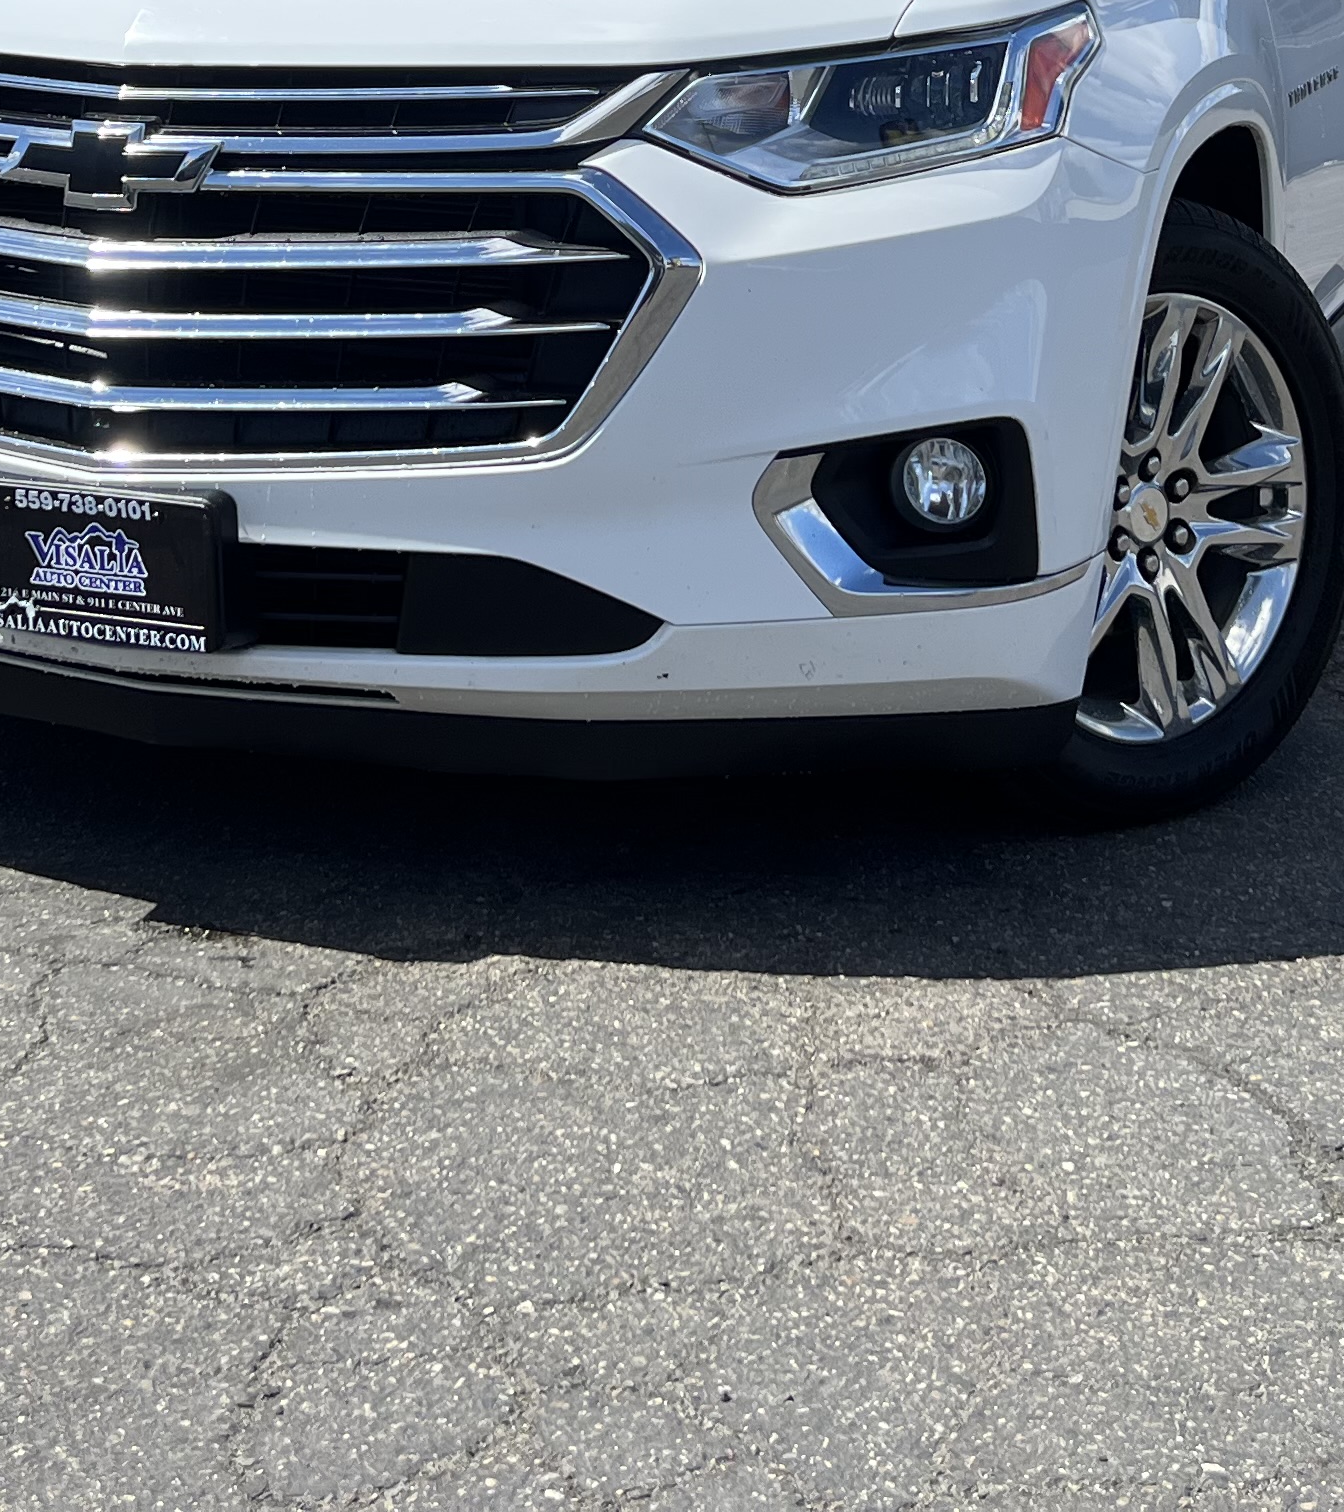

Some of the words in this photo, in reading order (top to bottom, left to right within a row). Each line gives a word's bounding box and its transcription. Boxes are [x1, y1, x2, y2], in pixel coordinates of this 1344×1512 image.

[14, 489, 151, 521] 559-738-0101
[25, 522, 148, 578] VISALIA
[30, 567, 77, 588] AUTO
[77, 572, 147, 596] CENTER
[30, 589, 60, 602] MAIN
[62, 592, 75, 604] ST
[76, 594, 85, 606] &
[87, 597, 105, 608] 911
[108, 599, 116, 609] E
[117, 600, 161, 614] CENTER
[162, 605, 185, 618] AVE
